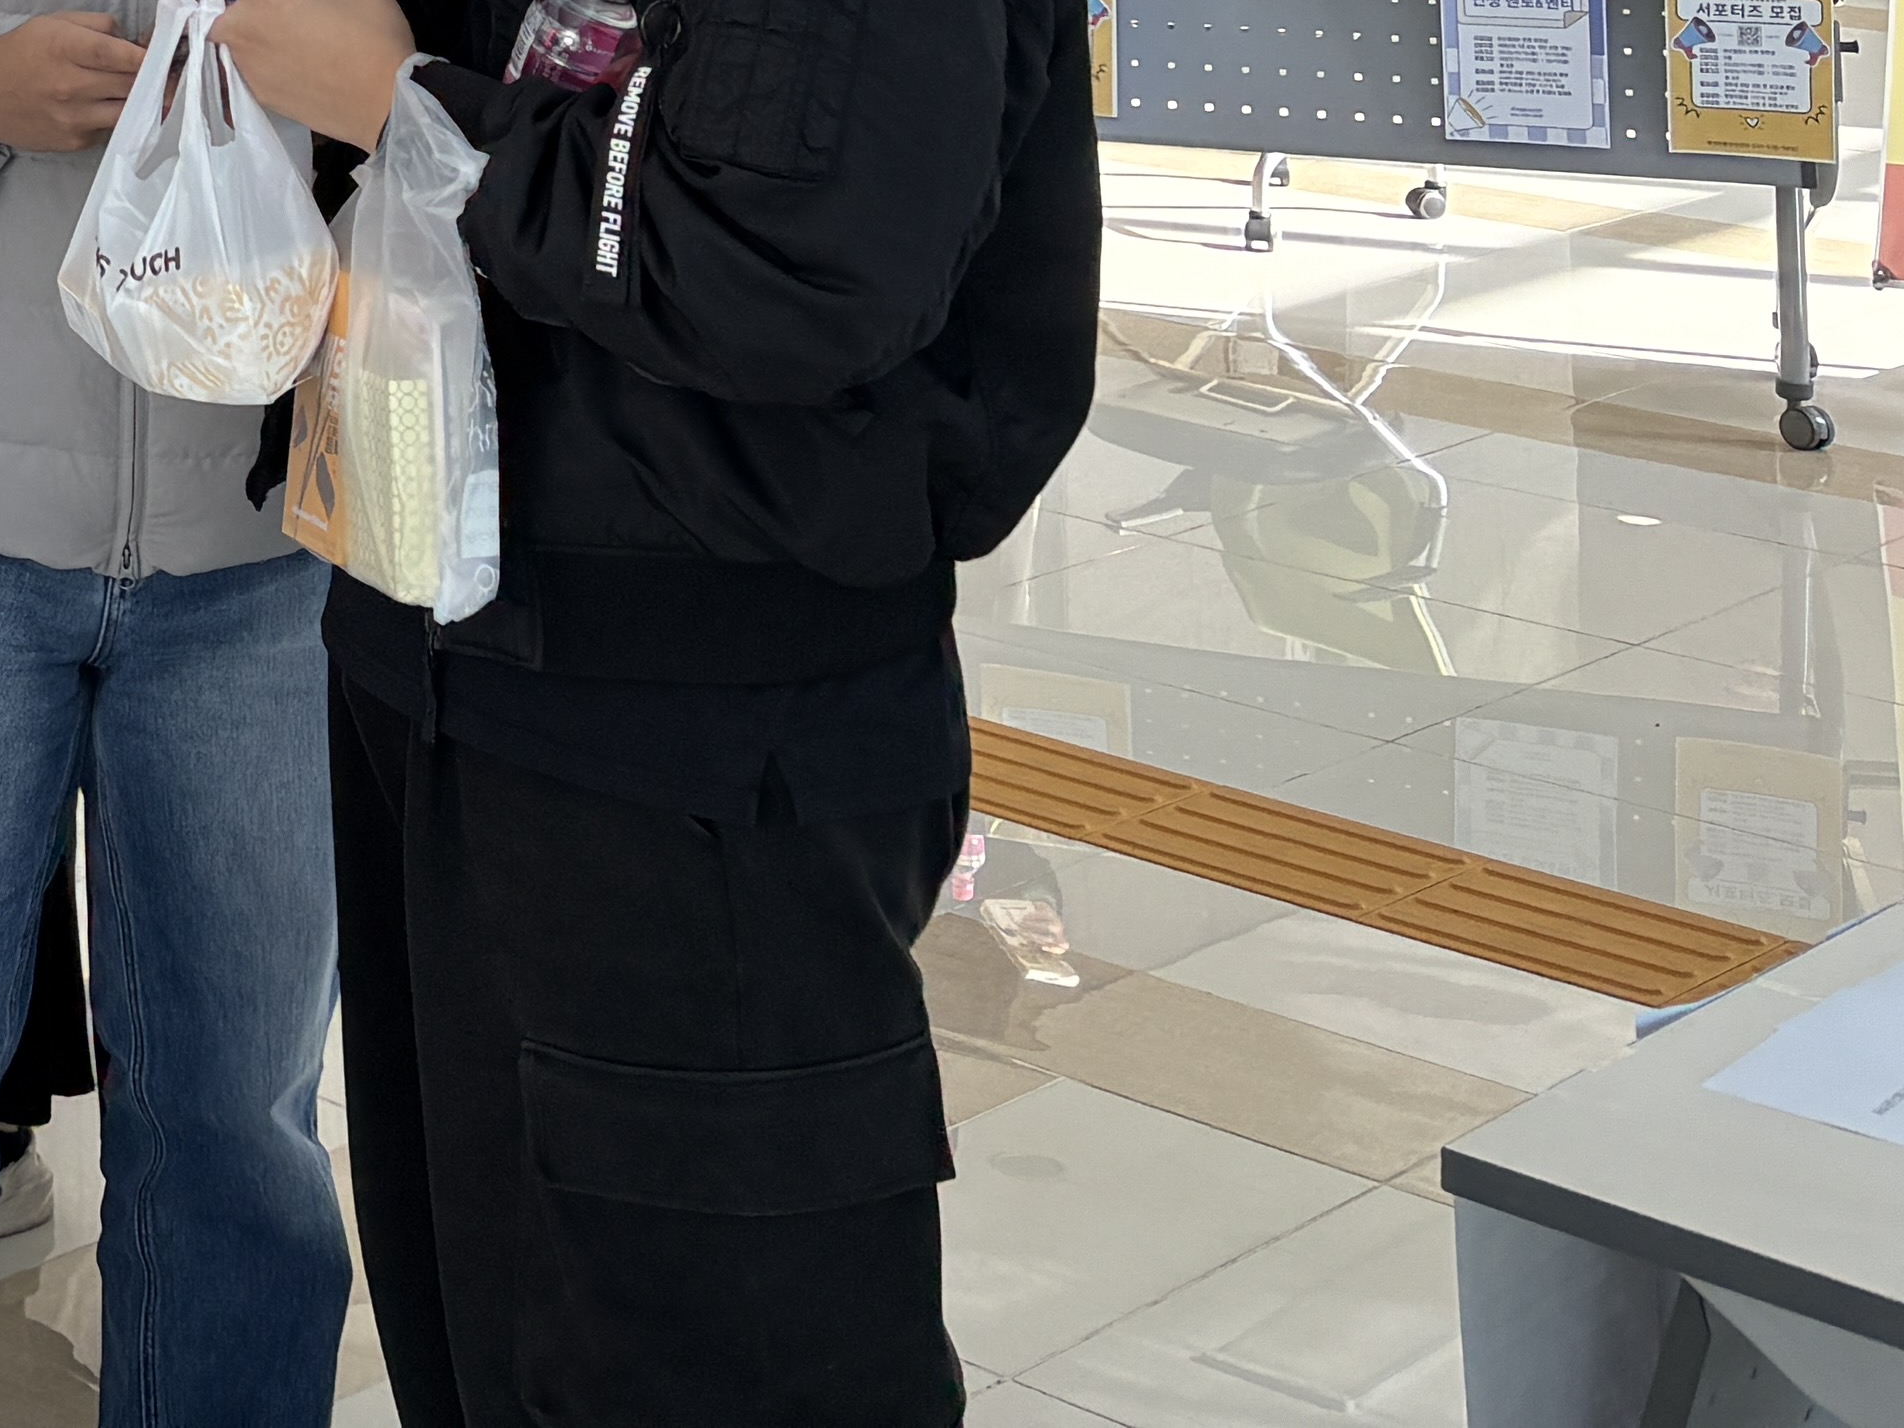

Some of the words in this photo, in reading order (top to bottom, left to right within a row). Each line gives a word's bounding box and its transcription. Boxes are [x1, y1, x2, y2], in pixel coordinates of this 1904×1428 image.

[1696, 1, 1764, 20] 서포터즈
[1769, 4, 1803, 22] 모집
[612, 65, 653, 138] REMOVE
[602, 139, 632, 212] BEFORE
[595, 210, 623, 279] FLIGHT
